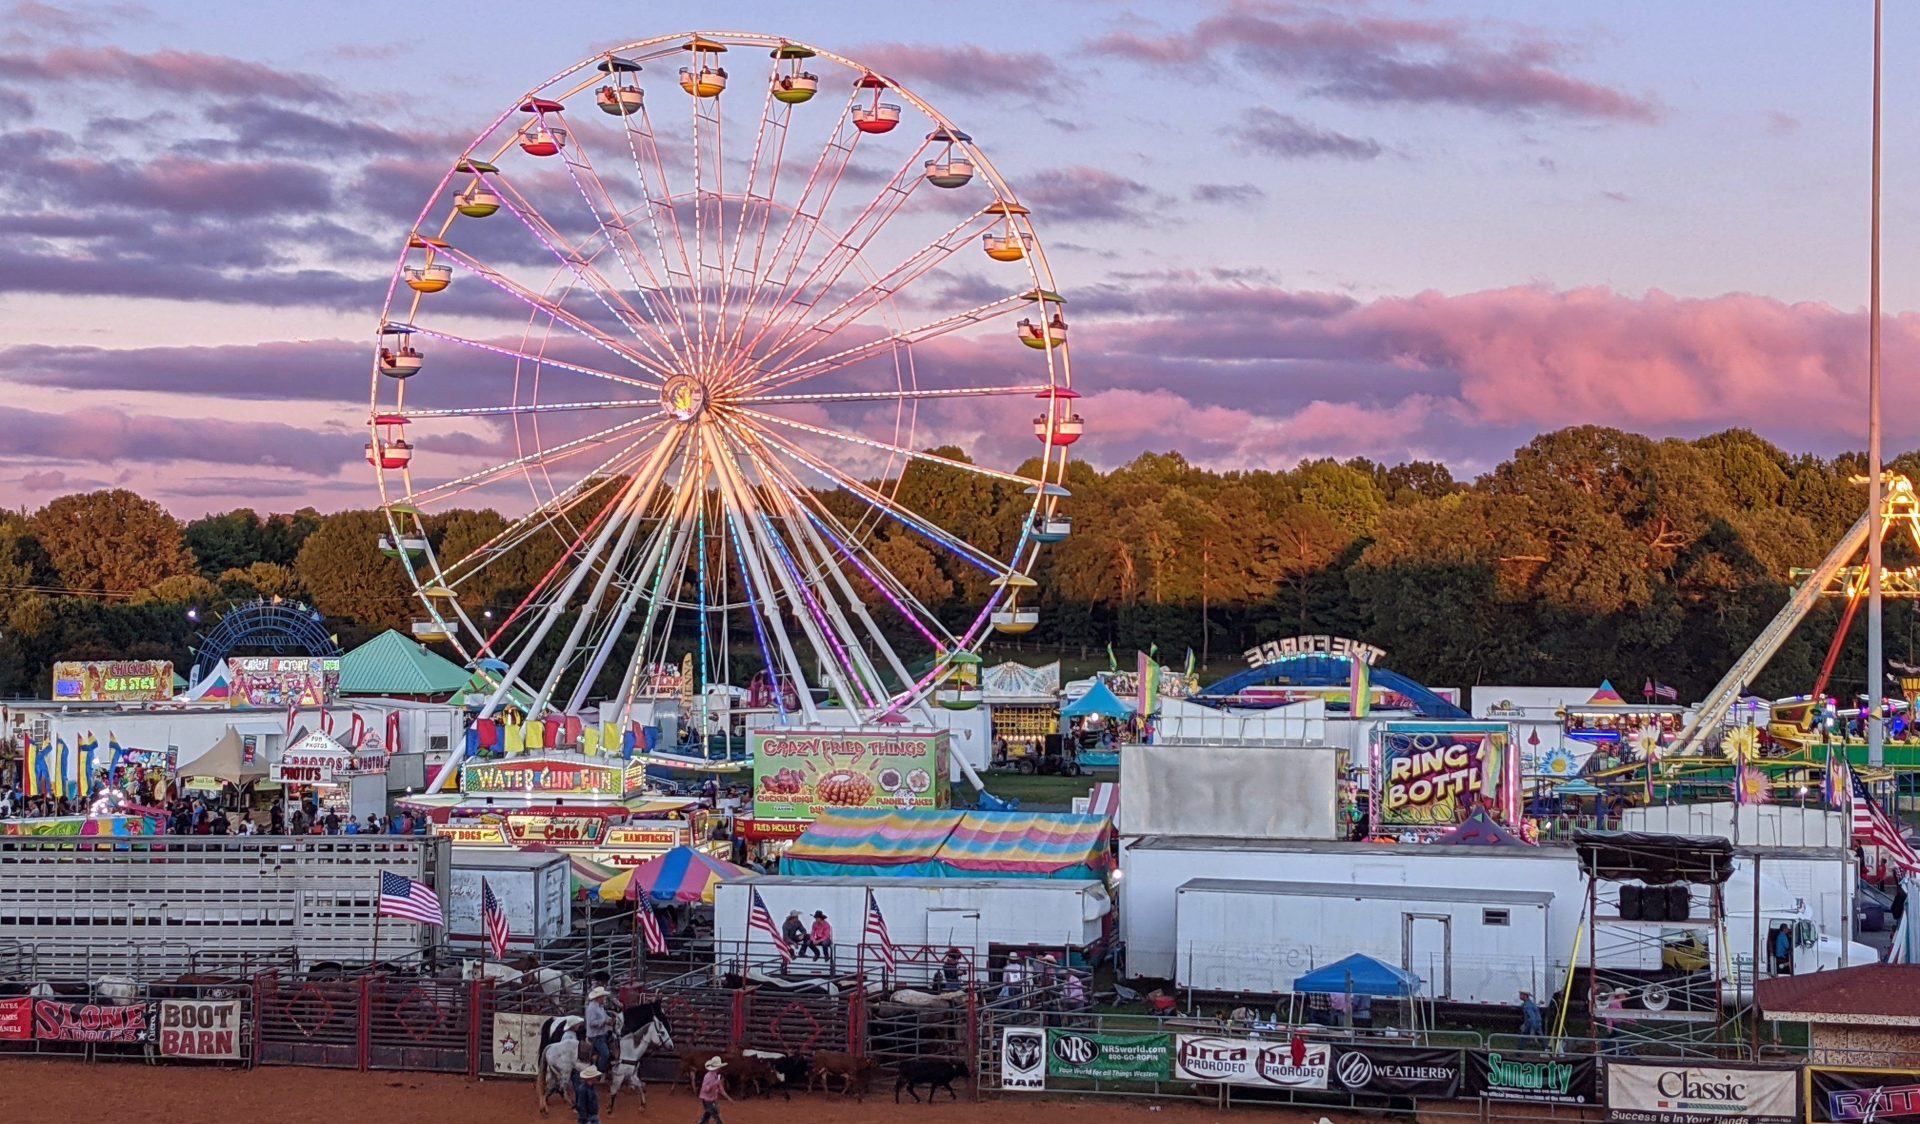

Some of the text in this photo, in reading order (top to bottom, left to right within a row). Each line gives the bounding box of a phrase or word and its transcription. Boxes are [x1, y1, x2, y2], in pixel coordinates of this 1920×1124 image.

[111, 662, 152, 676] CHICKEN
[684, 659, 692, 703] HENNA
[763, 739, 926, 757] CRAZY FRIED THINGS
[1391, 744, 1469, 781] RING
[280, 766, 322, 781] PHOTO'S
[477, 767, 611, 789] WATER GUN FUN
[1390, 767, 1482, 809] BOTTL
[876, 797, 933, 806] FUNNEL CAKES
[458, 830, 482, 841] DOGS
[771, 824, 796, 832] PICKLES
[624, 833, 673, 843] HAMBURGERS
[163, 1004, 234, 1028] BOOT
[162, 1030, 233, 1054] BARN
[1060, 1036, 1092, 1062] NRS
[1101, 1045, 1167, 1053] NRSworld.com
[1181, 1040, 1248, 1068] prca
[1074, 1068, 1092, 1076] World
[1092, 1069, 1102, 1077] for
[1103, 1069, 1112, 1077] all
[1111, 1070, 1133, 1078] Things
[1187, 1058, 1245, 1073] PRORODEO
[1265, 1065, 1324, 1078] PRORODEO
[1373, 1065, 1455, 1079] WEATHERBY
[1487, 1053, 1573, 1094] Smarty
[1003, 1079, 1043, 1087] RAM
[1657, 1070, 1747, 1101] Classic
[1610, 1110, 1657, 1122] Success
[1660, 1113, 1670, 1122] Is
[1673, 1114, 1683, 1123] In
[1686, 1115, 1711, 1124] Your
[1714, 1116, 1749, 1124] Hands
